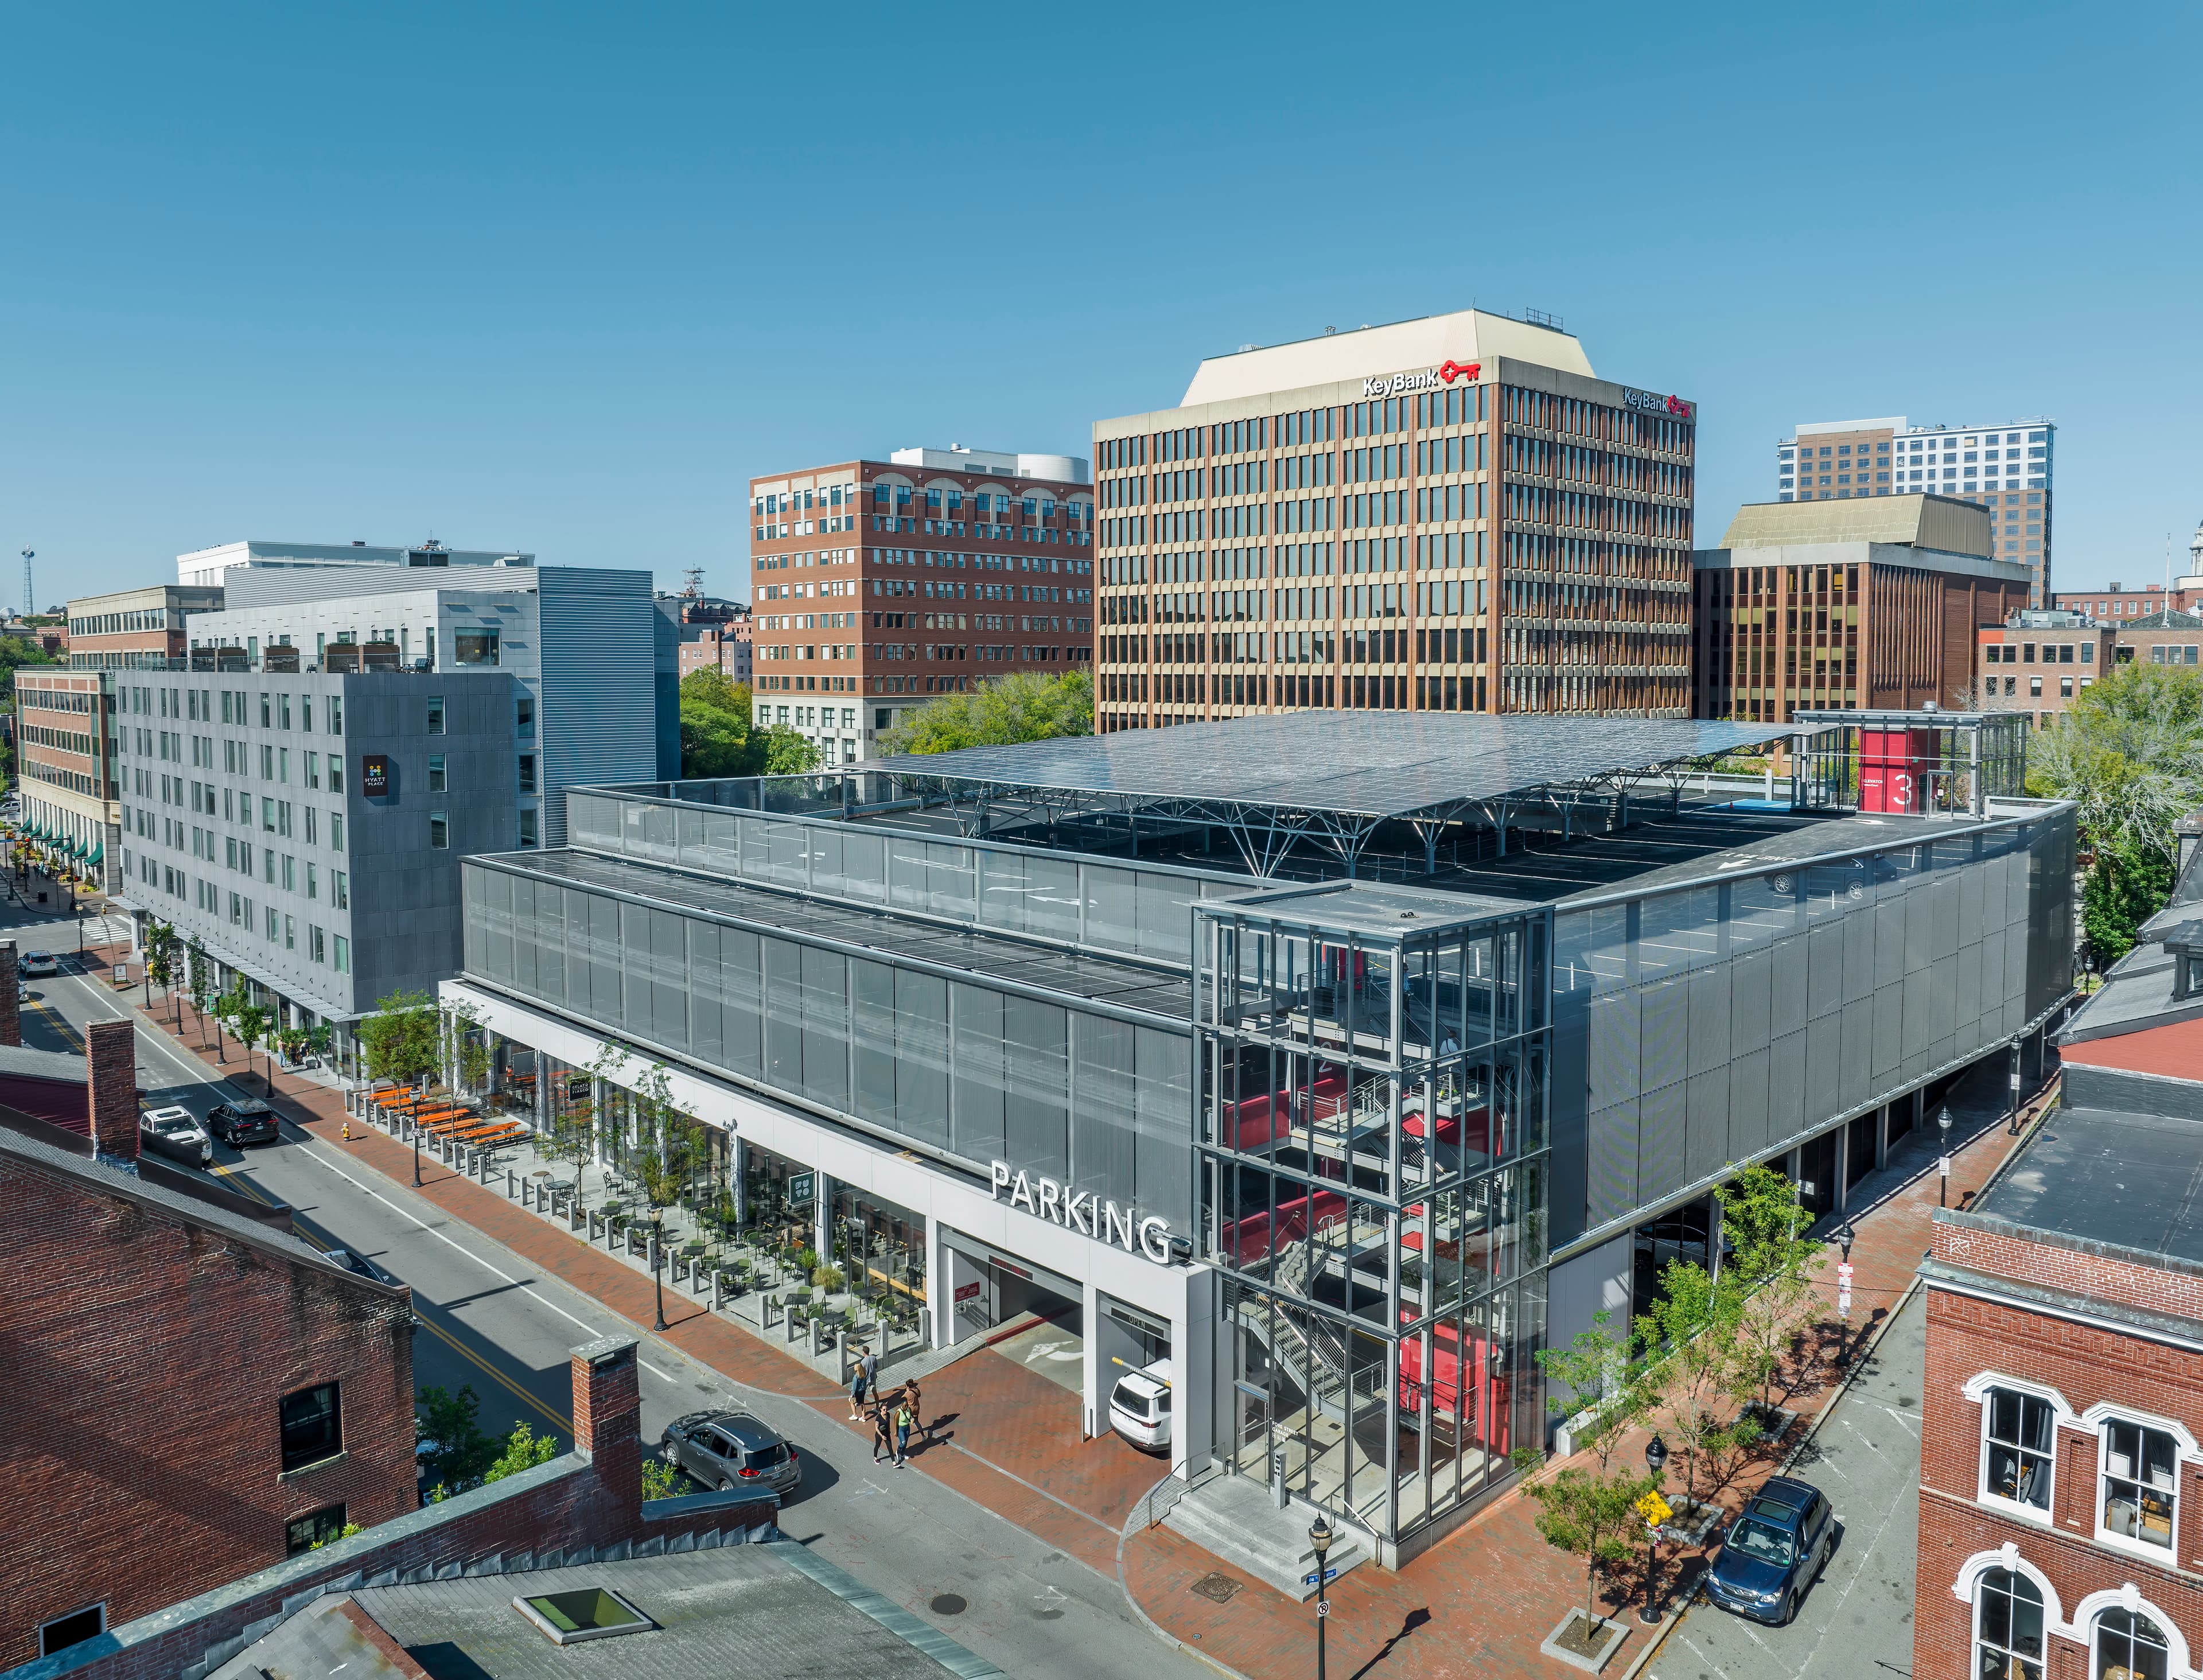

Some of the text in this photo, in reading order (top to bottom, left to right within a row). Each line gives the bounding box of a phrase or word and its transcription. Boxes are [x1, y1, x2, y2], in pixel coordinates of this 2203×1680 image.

[1363, 368, 1438, 396] KeyBank
[1624, 388, 1668, 413] KeyBank
[1893, 774, 1912, 805] 3
[991, 1159, 1173, 1264] PARKING
[1129, 1315, 1145, 1329] OPEN
[1272, 1421, 1299, 1436] FORE STREET
[1272, 1427, 1289, 1438] GARAGE
